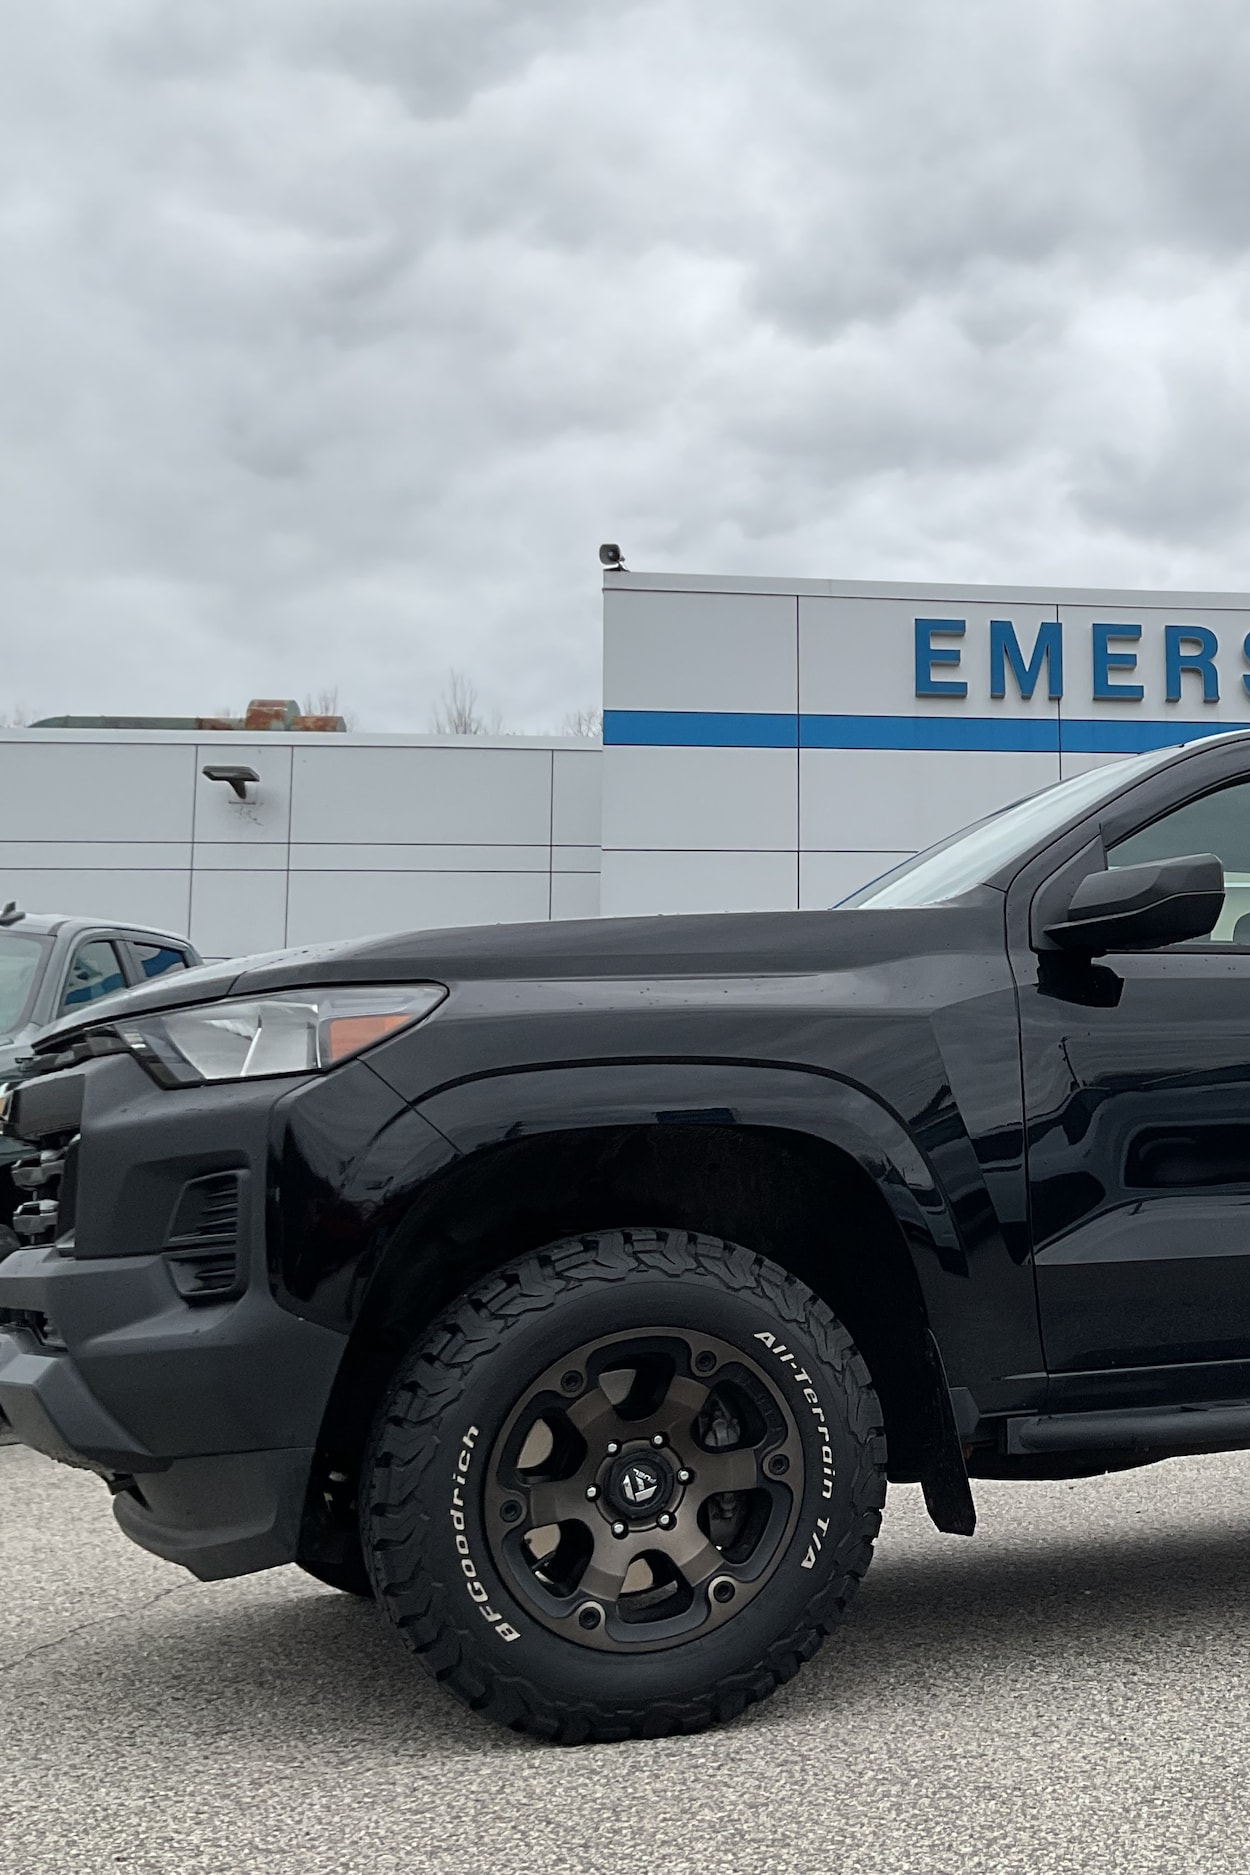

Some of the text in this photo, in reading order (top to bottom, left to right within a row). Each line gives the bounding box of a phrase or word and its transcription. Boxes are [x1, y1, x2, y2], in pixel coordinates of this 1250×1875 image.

[450, 1426, 521, 1642] BFGoodrich
[753, 1331, 836, 1569] All-Terrain T/A
